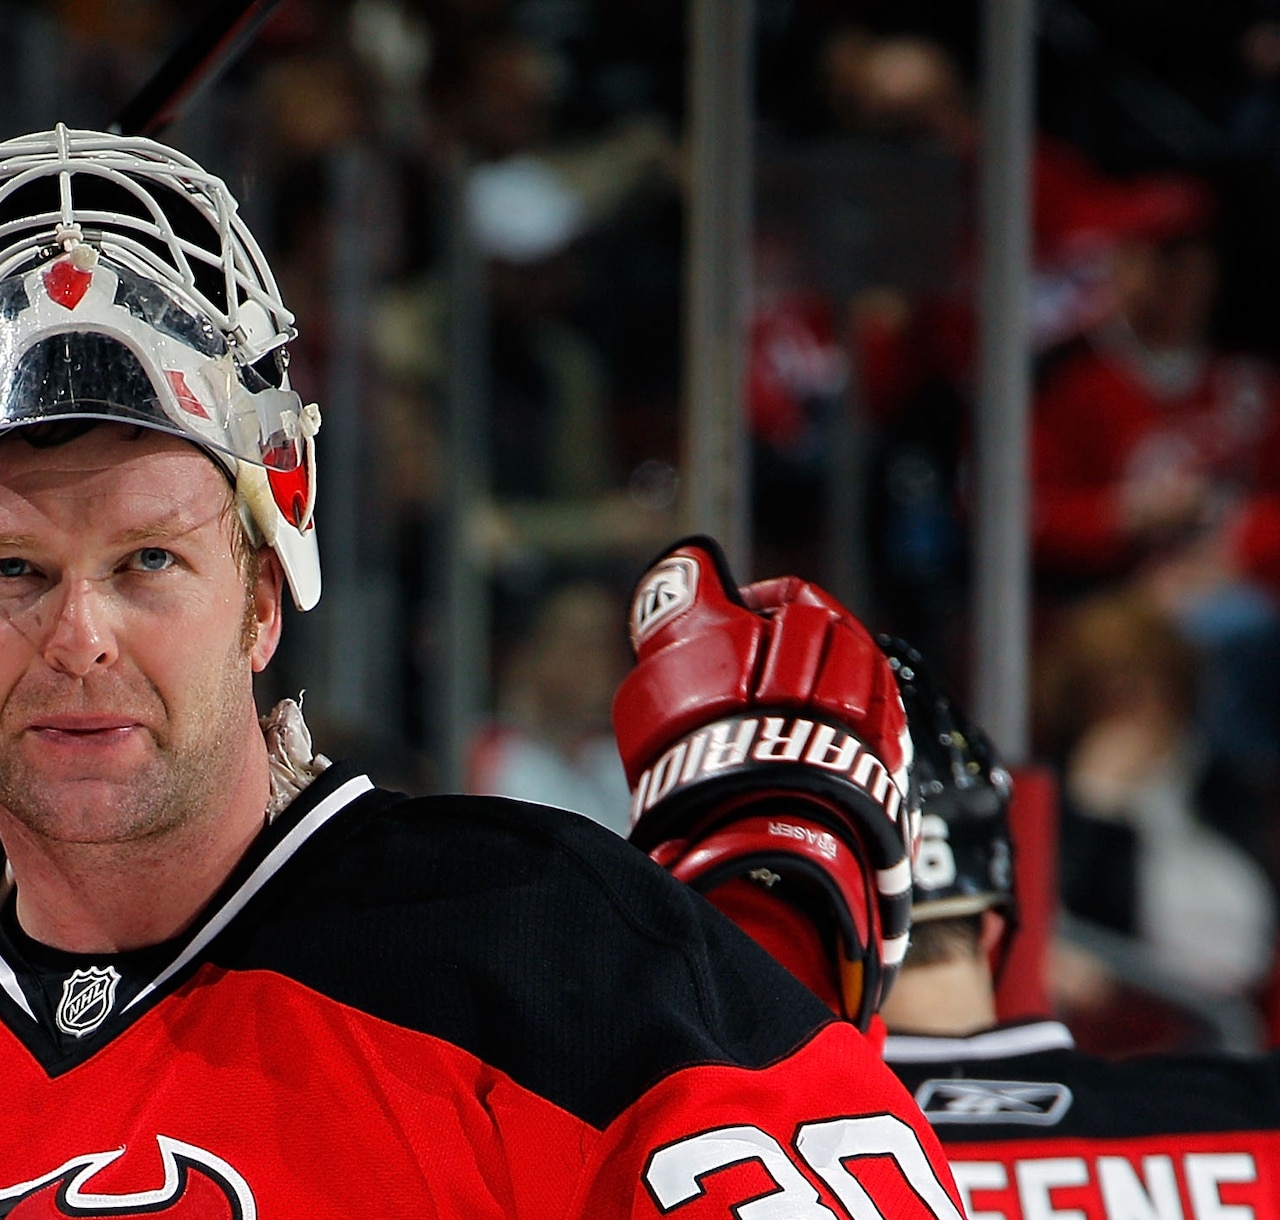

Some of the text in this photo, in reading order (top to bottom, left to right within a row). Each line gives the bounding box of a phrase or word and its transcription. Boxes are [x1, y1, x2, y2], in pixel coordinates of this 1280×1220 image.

[768, 821, 837, 858] FRASER
[913, 814, 957, 891] 6
[68, 982, 105, 1021] NHL
